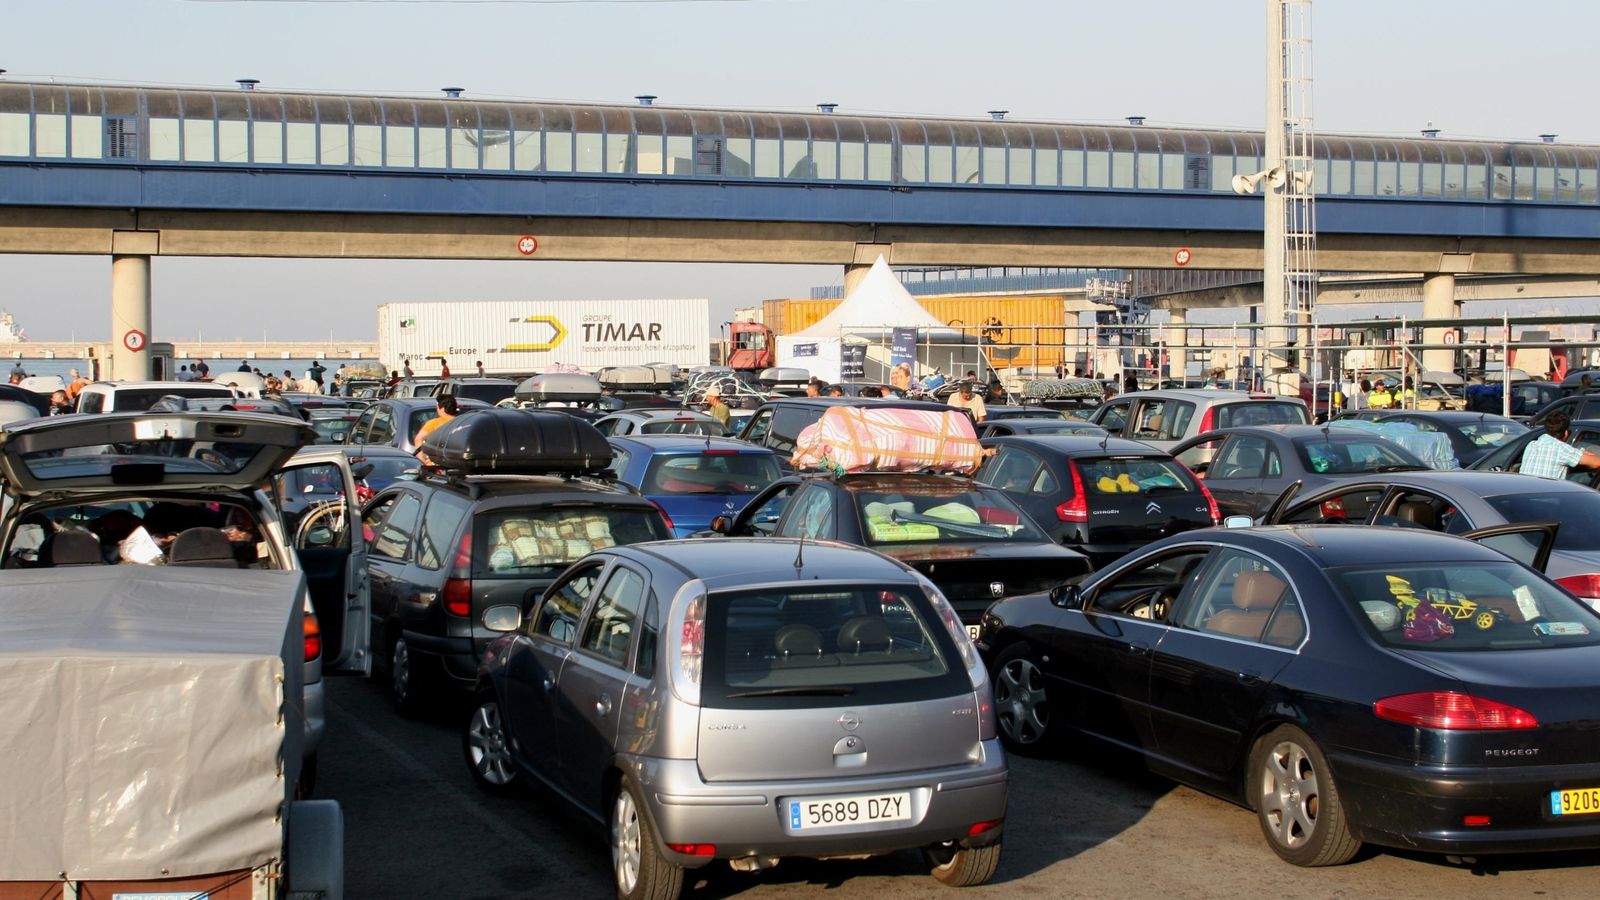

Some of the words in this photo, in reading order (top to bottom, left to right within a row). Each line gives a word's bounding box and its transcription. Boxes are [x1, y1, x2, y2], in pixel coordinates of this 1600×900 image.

[582, 322, 662, 342] TIMAR
[449, 347, 477, 355] Europe
[1485, 748, 1540, 756] PEUGEOT
[809, 801, 859, 824] 5689
[868, 796, 902, 819] DZY
[1563, 791, 1600, 811] 9206
